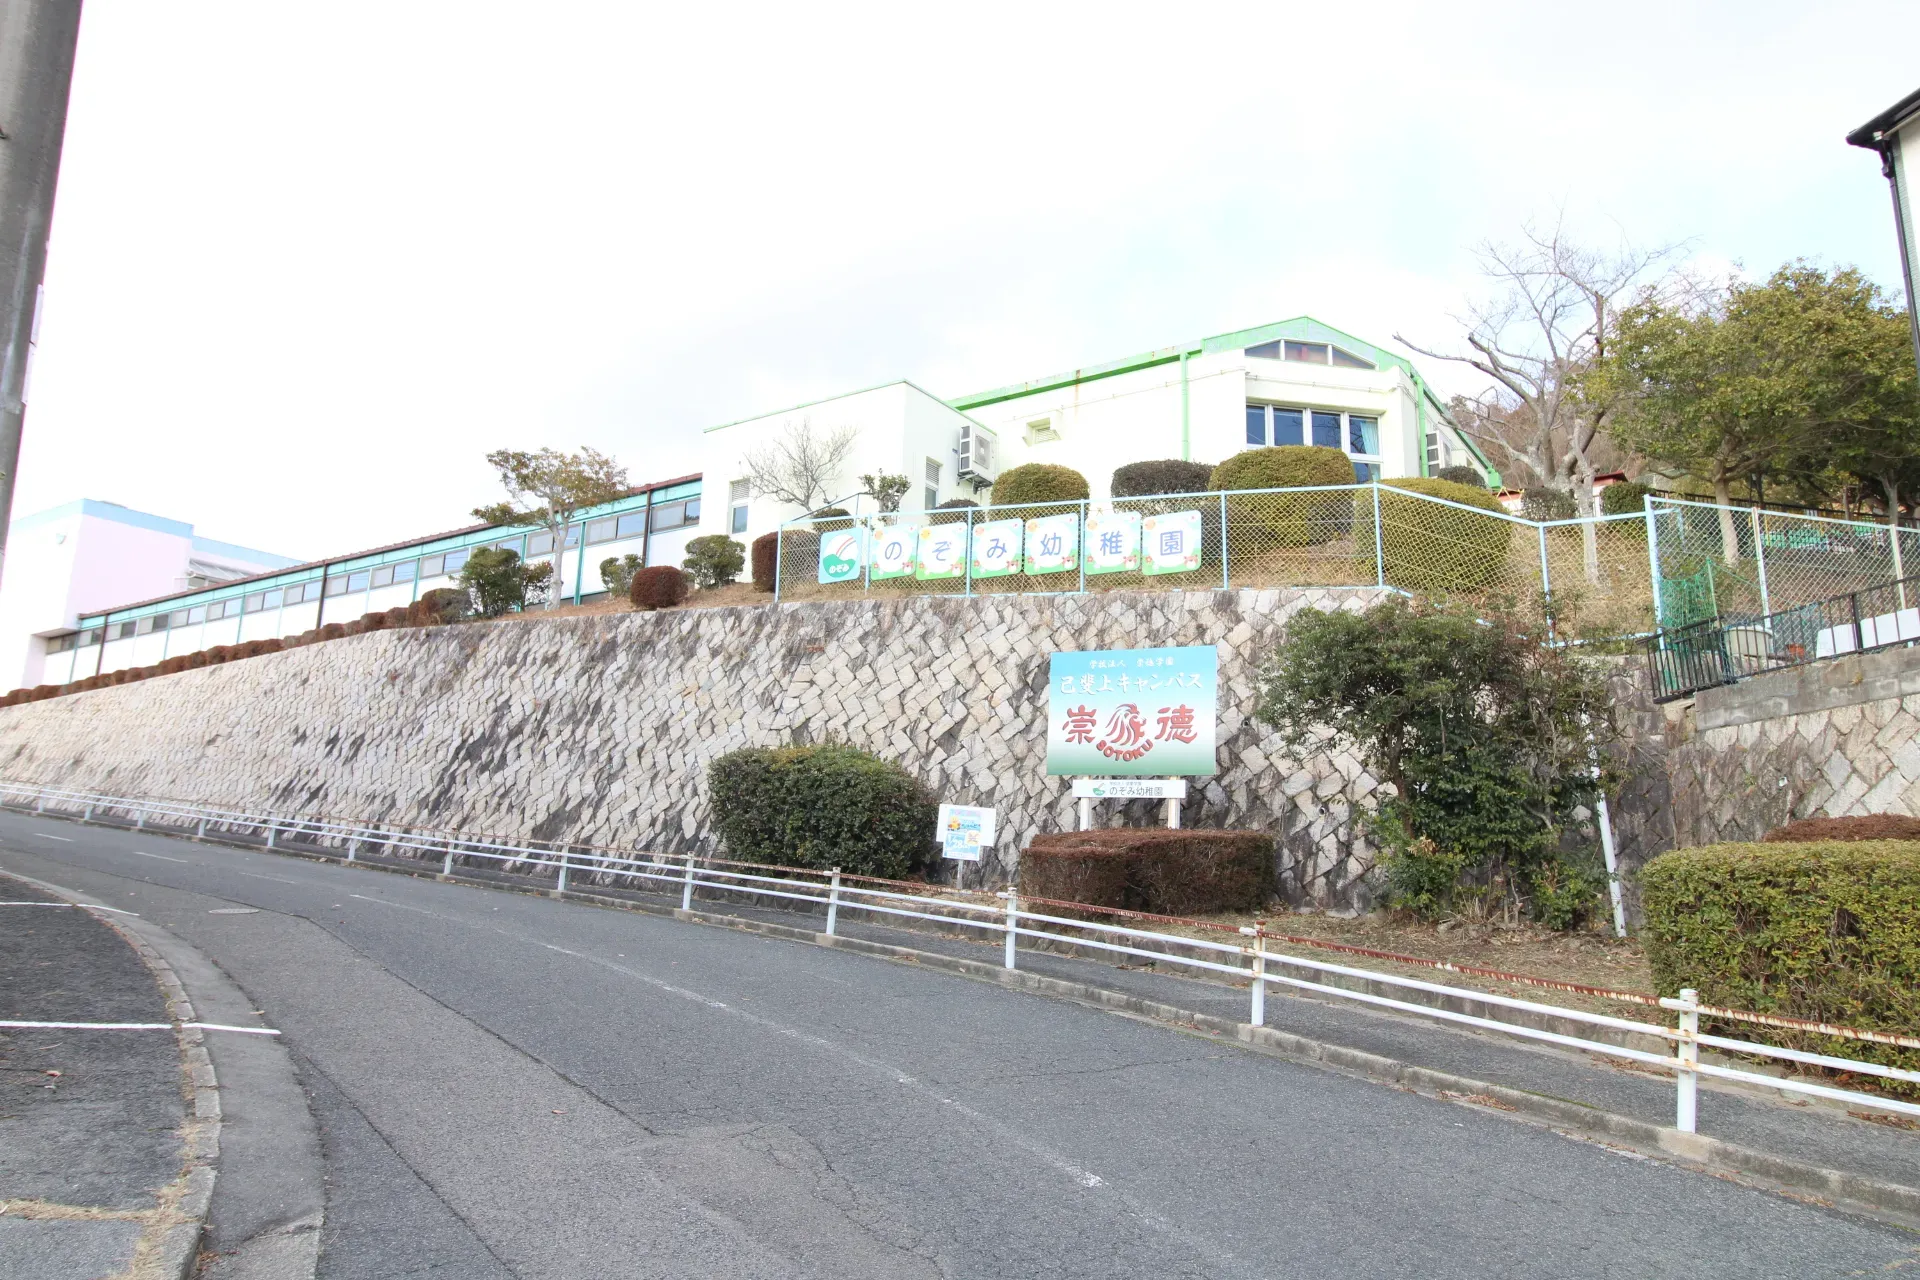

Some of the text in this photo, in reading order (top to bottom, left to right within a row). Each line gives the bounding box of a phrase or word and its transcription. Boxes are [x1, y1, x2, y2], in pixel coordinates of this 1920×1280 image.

[884, 529, 1184, 563] のぞみ幼稚園
[1062, 704, 1097, 745] 崇
[1096, 738, 1154, 762] SOTOKU
[1109, 786, 1163, 797] のぞみ幼稚園
